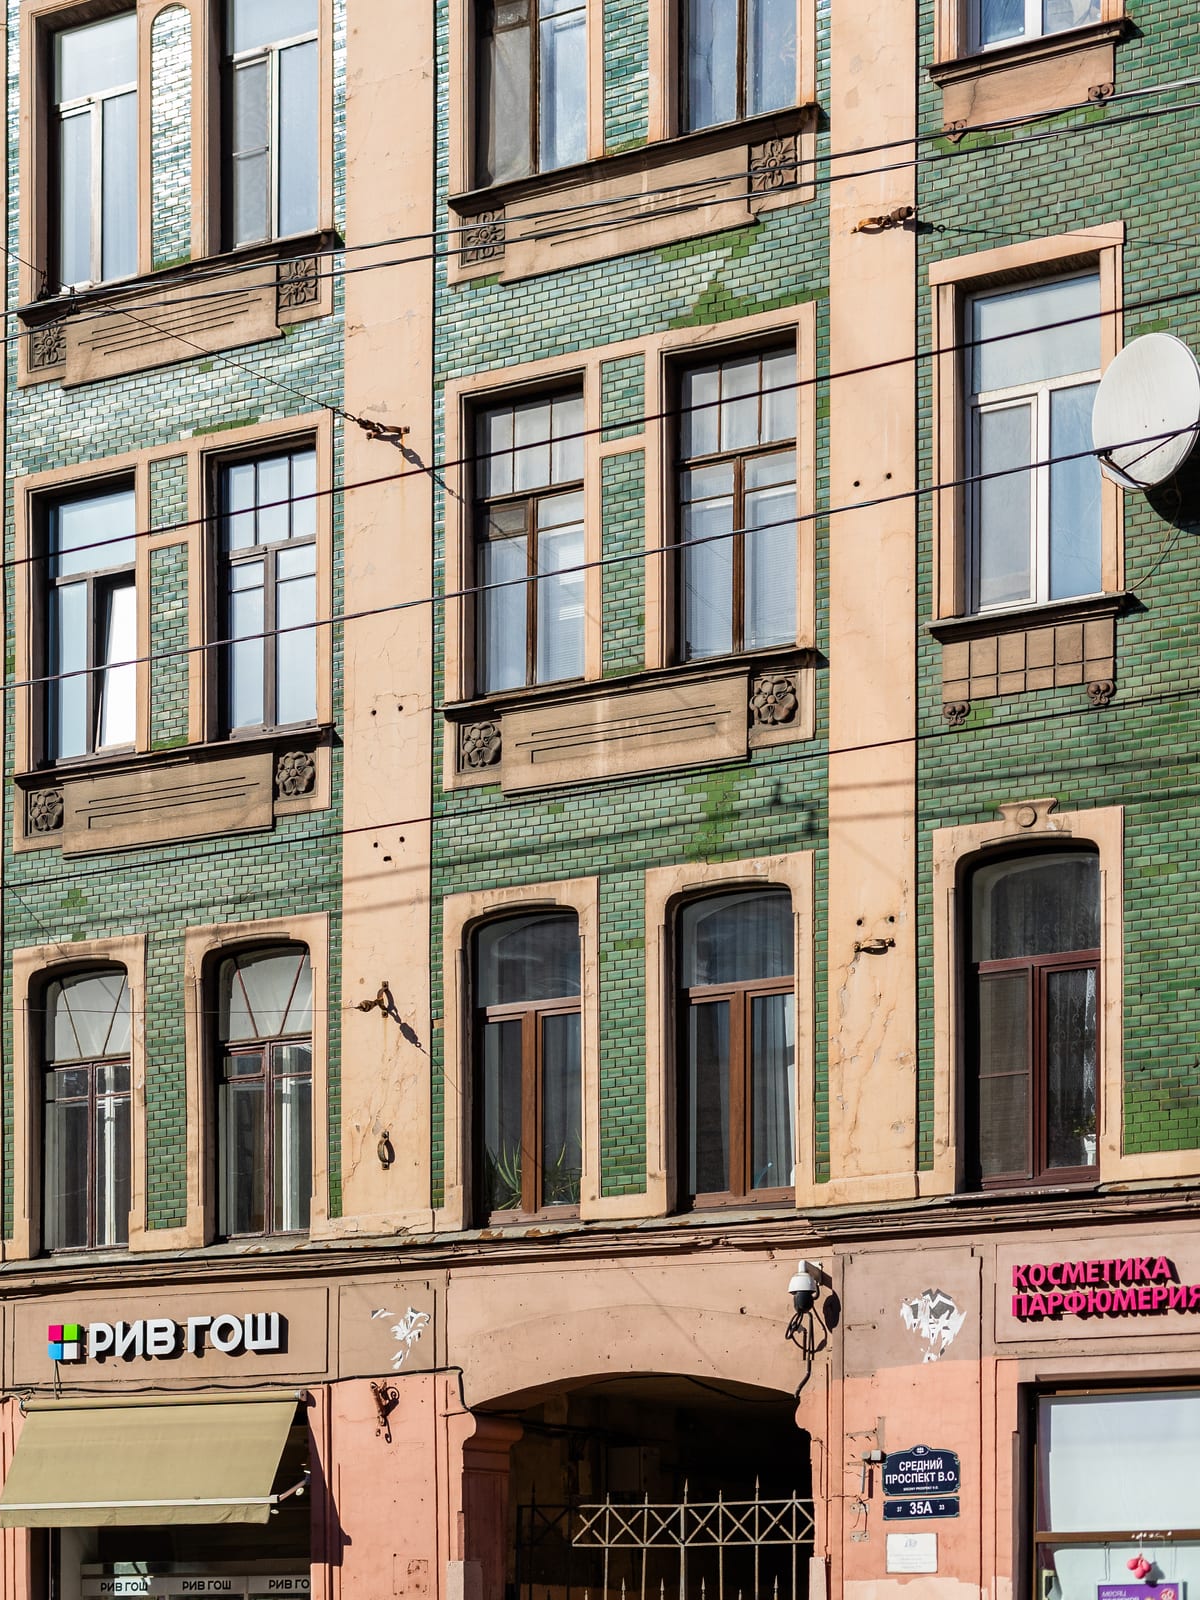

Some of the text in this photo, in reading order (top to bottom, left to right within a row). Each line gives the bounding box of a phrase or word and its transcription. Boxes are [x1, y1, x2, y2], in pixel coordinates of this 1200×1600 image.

[1012, 1256, 1171, 1287] КОСМЕТИКА
[1012, 1284, 1200, 1316] ПАРФЮМЕРИЯ
[89, 1312, 280, 1358] РИВ ГОШ
[899, 1457, 943, 1472] СРЕДНИЙ
[885, 1471, 957, 1485] ПРОСПЕКТ В.О.
[909, 1501, 933, 1515] 35А
[101, 1582, 147, 1592] РИВ ГОШ
[182, 1580, 231, 1590] РИВ ГОШ
[269, 1579, 310, 1589] РИВ ГО
